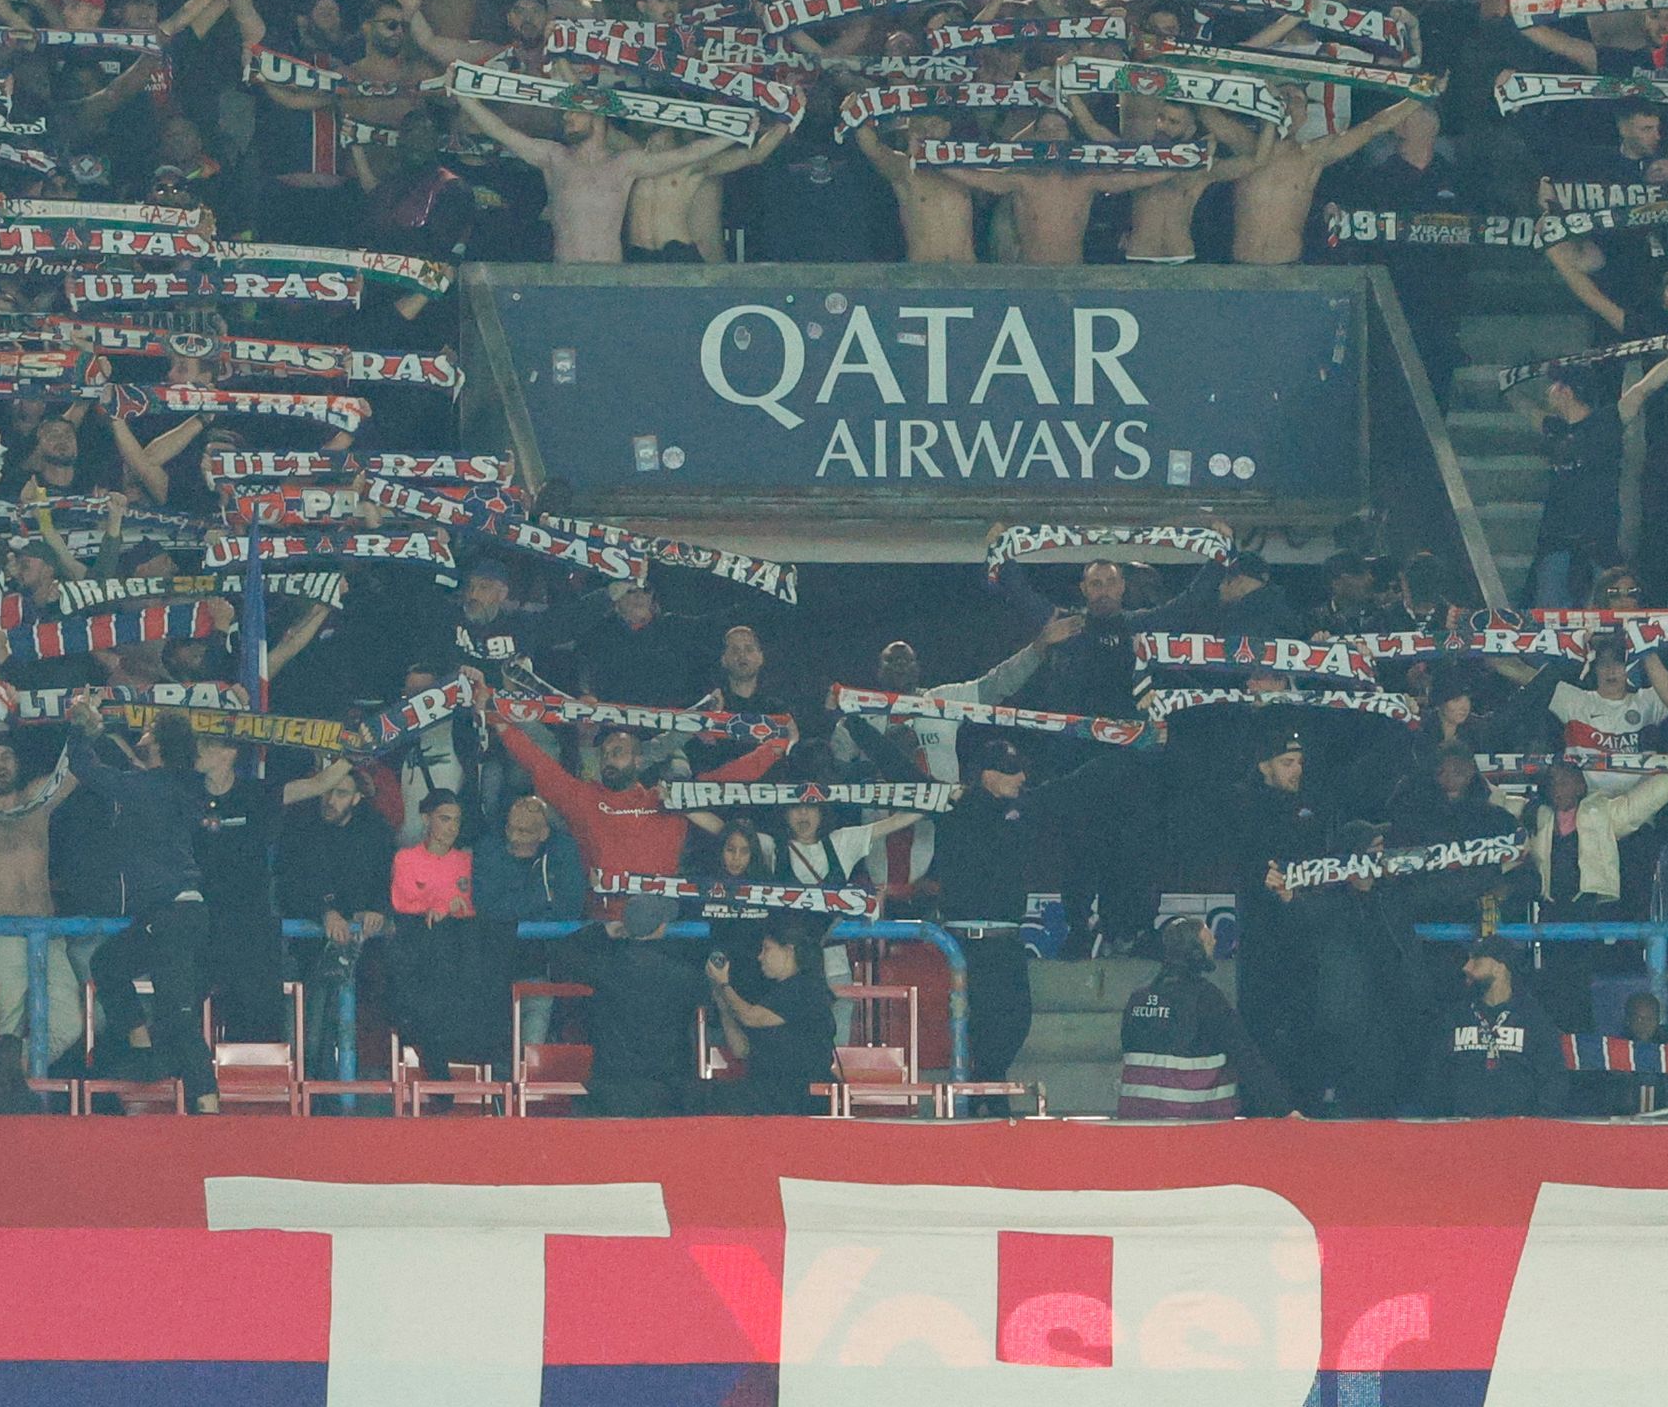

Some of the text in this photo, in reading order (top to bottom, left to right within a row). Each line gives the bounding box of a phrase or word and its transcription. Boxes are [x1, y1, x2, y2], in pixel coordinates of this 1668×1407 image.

[700, 304, 1149, 430] QATAR
[816, 420, 1152, 480] AIRWAYS
[563, 703, 702, 731] PARIS
[828, 783, 957, 814] AUTEUIL
